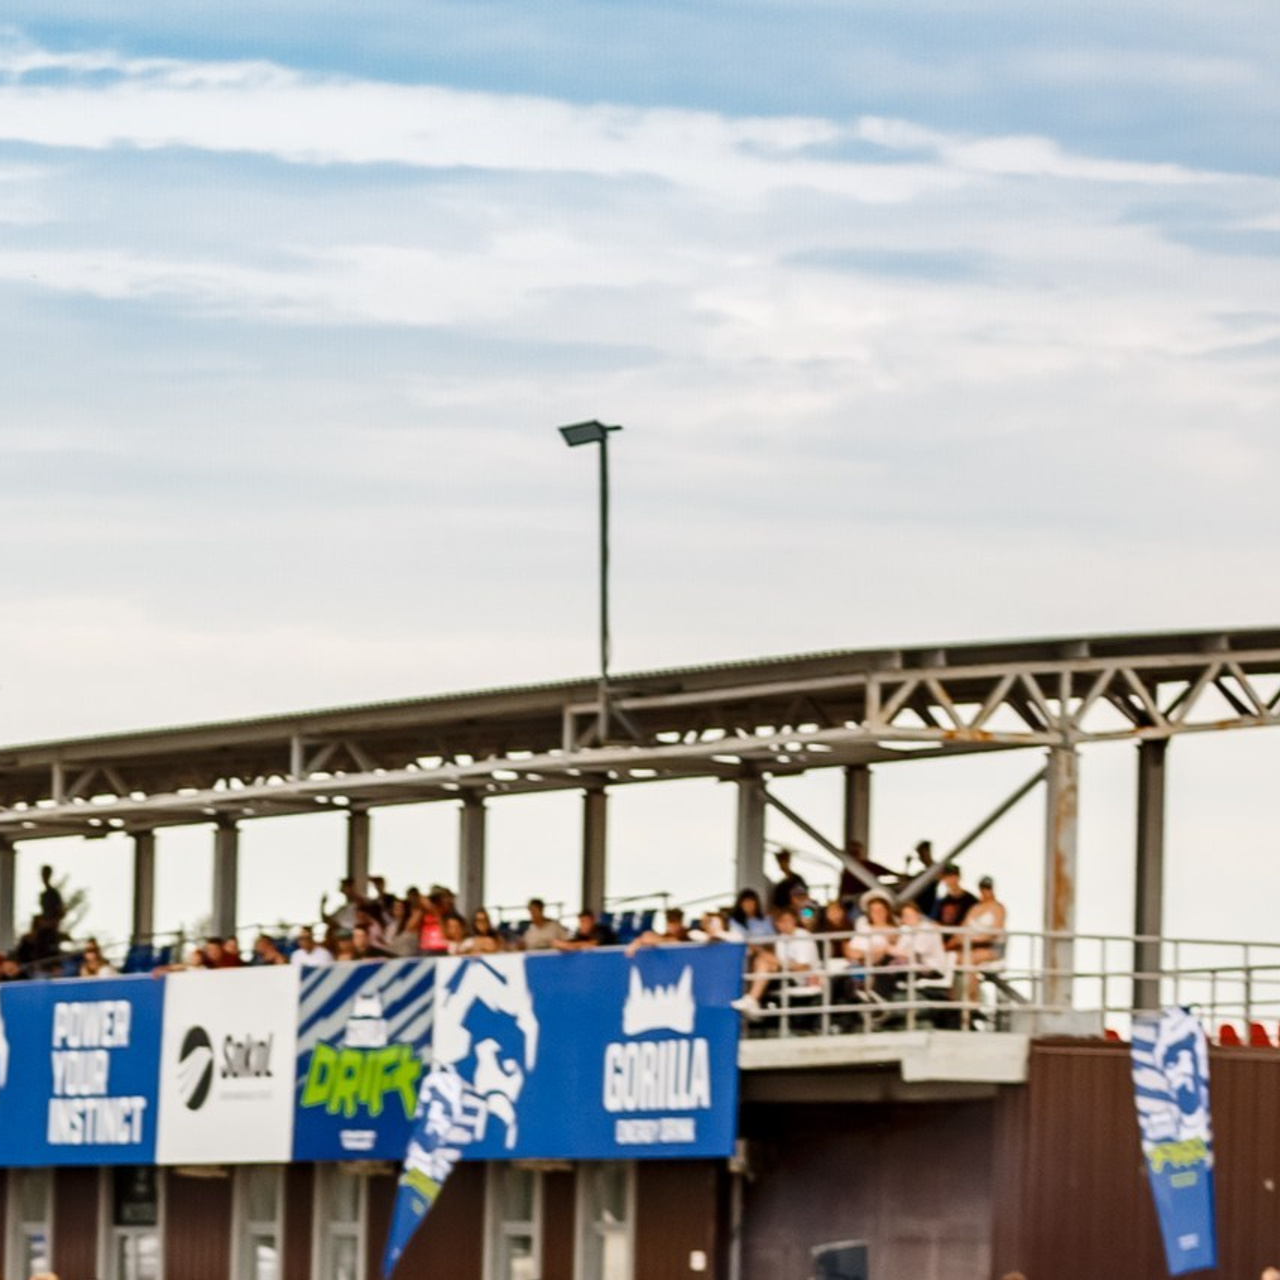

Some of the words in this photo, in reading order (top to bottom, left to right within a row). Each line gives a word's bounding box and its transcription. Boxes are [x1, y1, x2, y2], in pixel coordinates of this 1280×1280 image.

[53, 1000, 131, 1048] POWER
[52, 1048, 109, 1096] YOUR
[302, 1042, 423, 1120] DRIFT
[603, 1037, 712, 1113] GORILLA
[48, 1097, 147, 1144] INSTINCT
